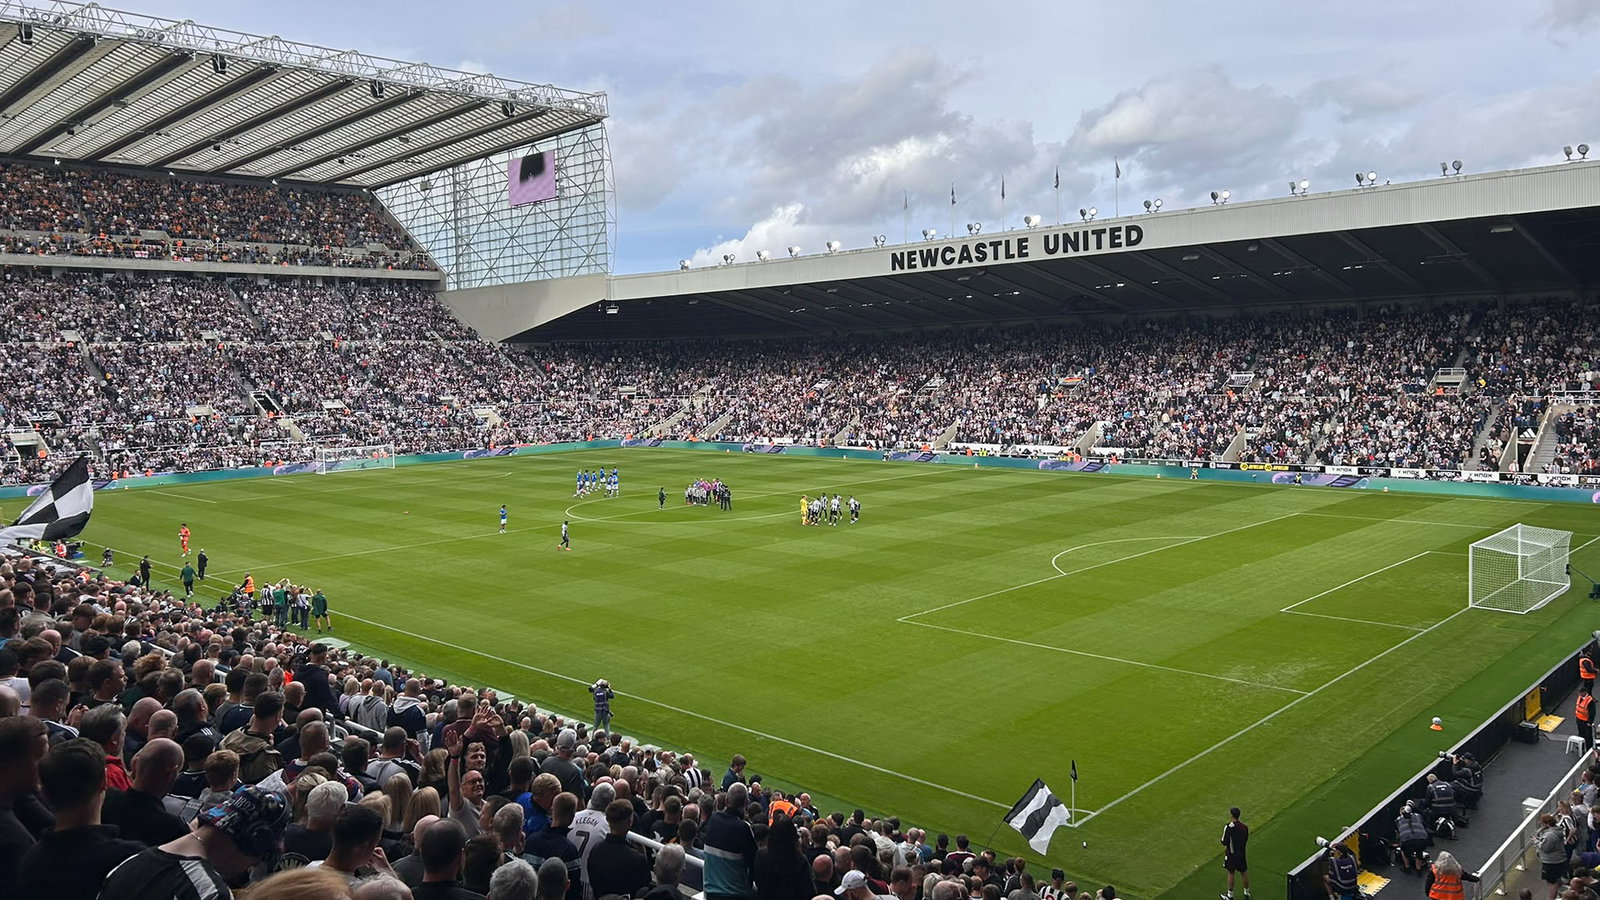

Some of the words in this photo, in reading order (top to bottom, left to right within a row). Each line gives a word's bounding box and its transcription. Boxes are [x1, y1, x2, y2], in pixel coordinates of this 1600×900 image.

[891, 237, 1029, 271] NEWCASTLE
[1043, 224, 1144, 255] UNITED
[575, 816, 599, 828] KEEGAN
[575, 830, 590, 858] 7
